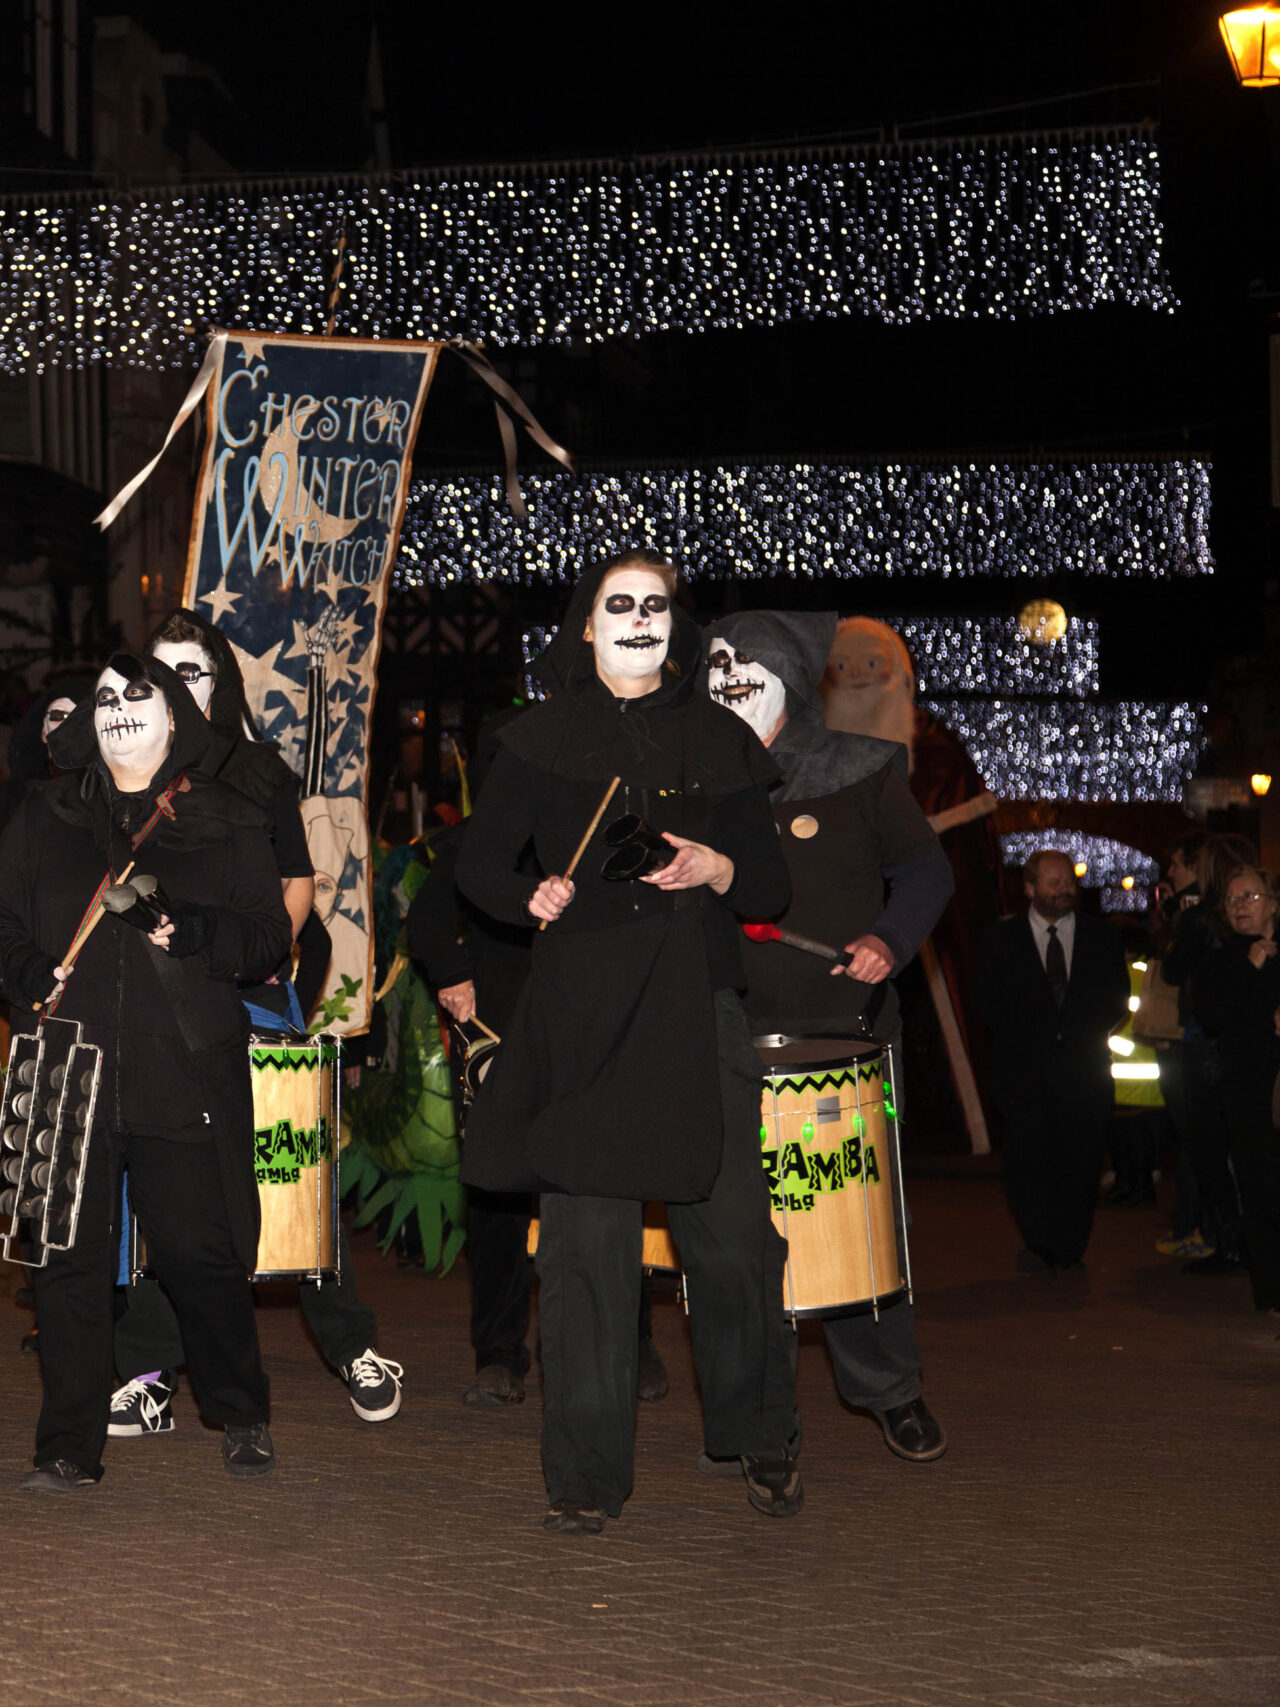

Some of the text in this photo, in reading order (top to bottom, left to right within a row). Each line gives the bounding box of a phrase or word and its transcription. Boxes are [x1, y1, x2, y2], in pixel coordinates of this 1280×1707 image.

[219, 364, 412, 450] CHESTER
[216, 448, 401, 577] WINTER
[278, 517, 389, 594] WATCH
[256, 1167, 300, 1184] amba
[761, 1136, 880, 1191] RAMBA
